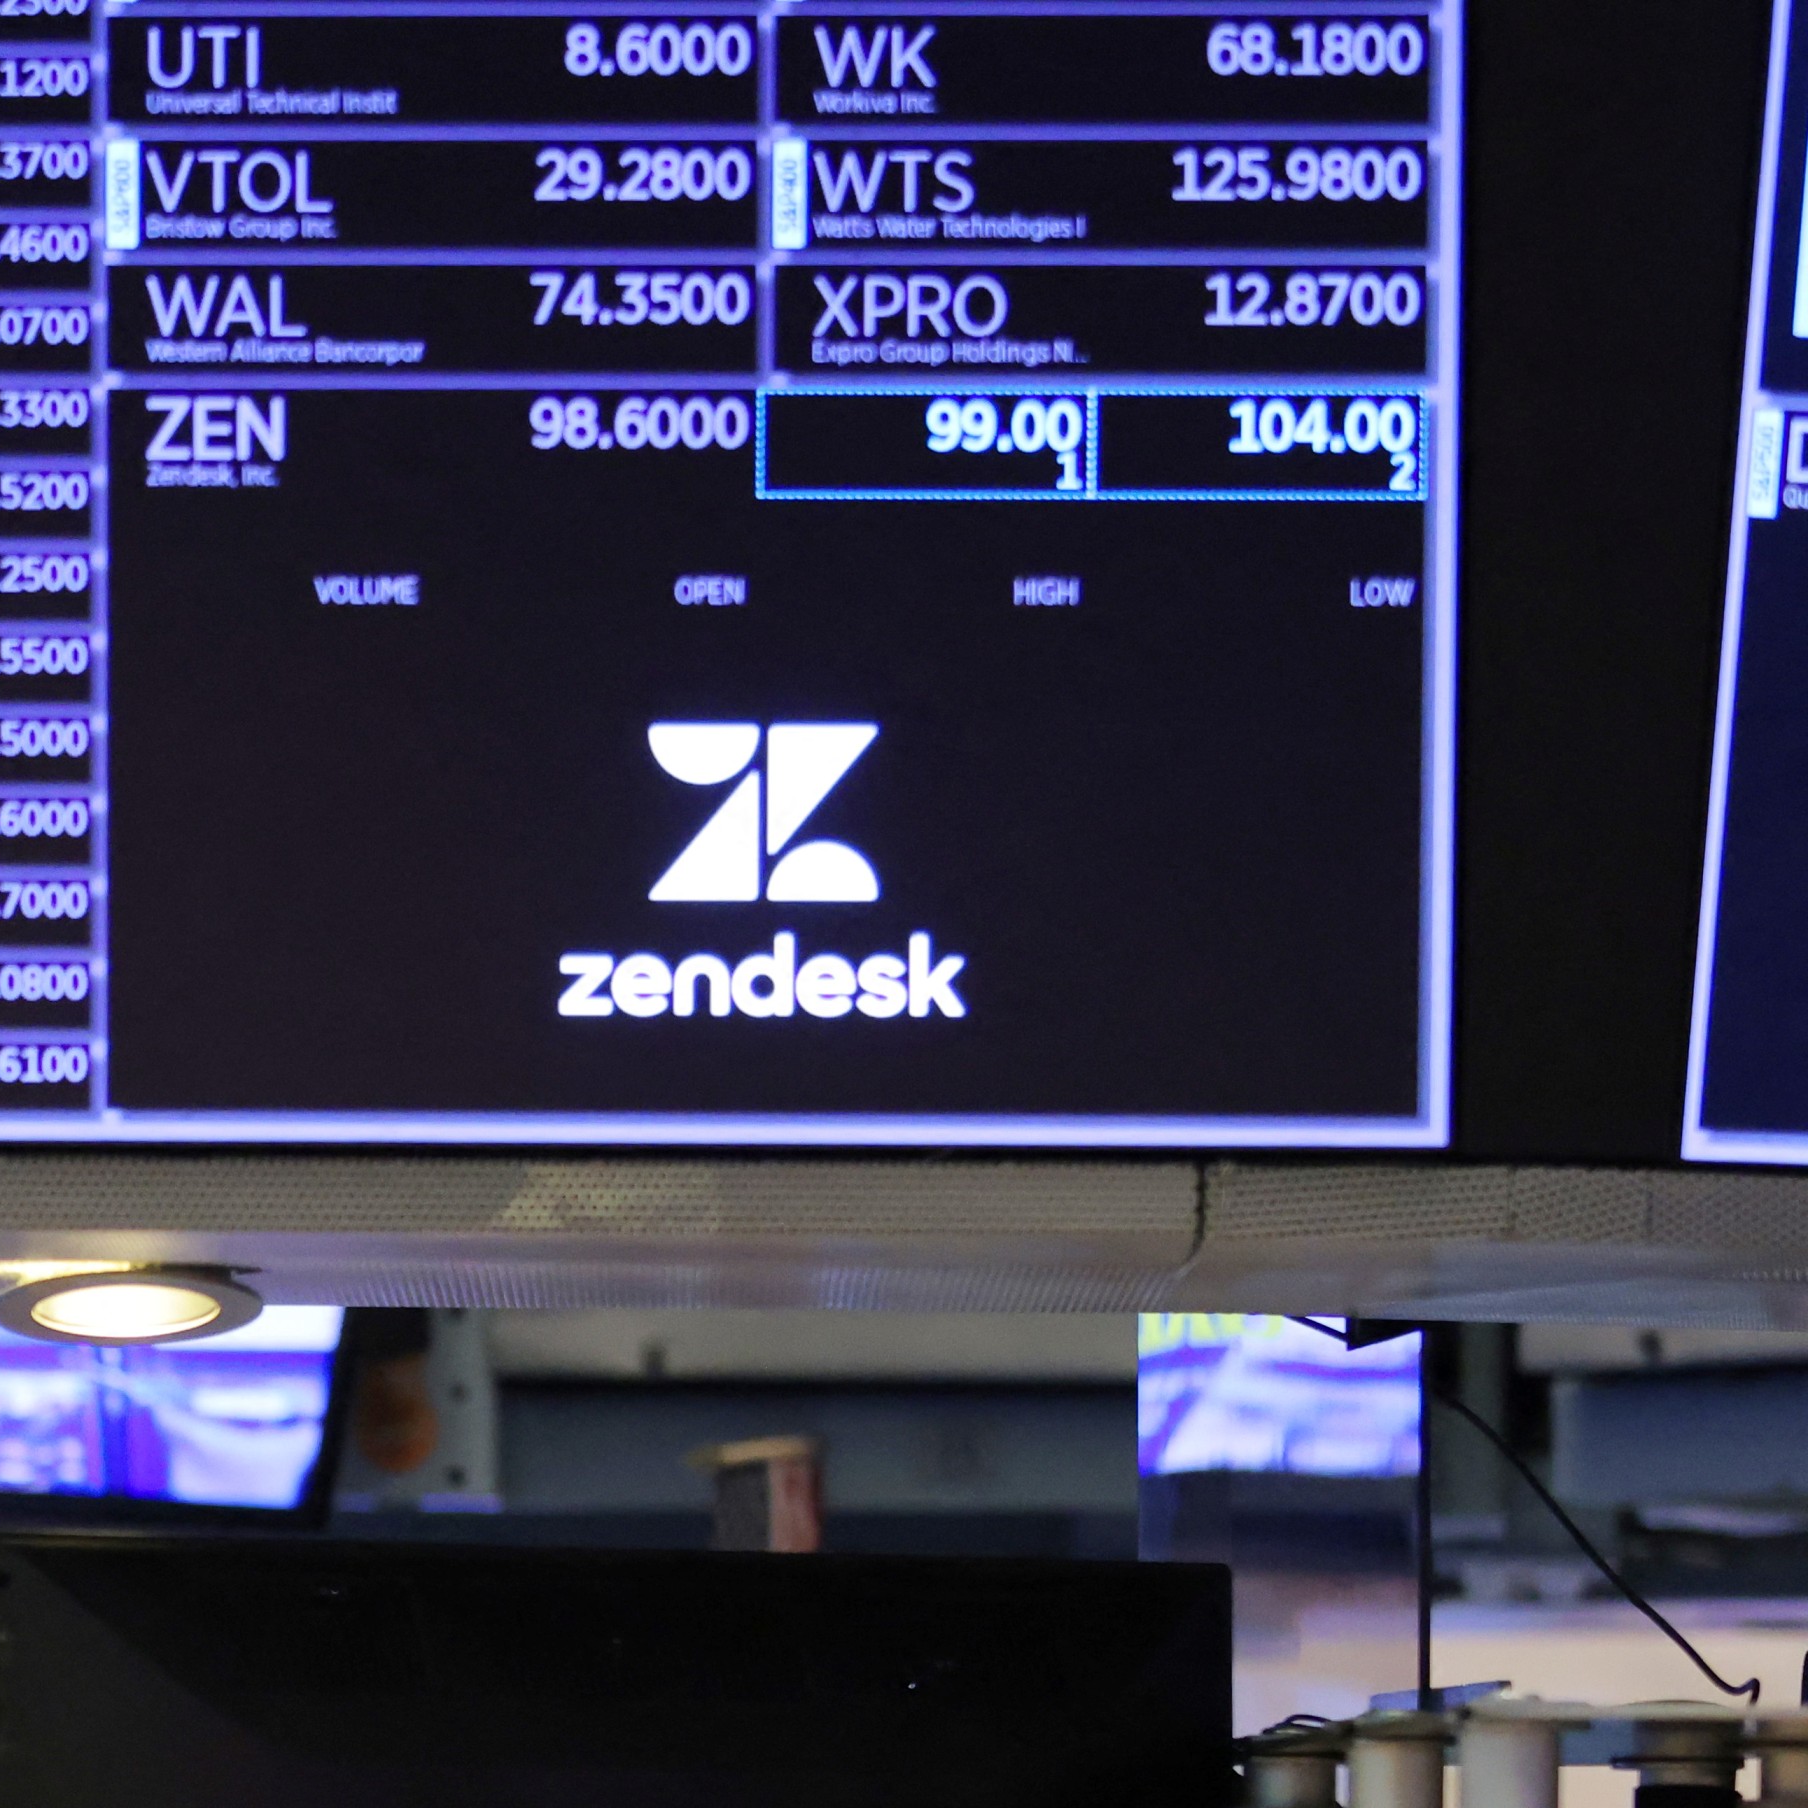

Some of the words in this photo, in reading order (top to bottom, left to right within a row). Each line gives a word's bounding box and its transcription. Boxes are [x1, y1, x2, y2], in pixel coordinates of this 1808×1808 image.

[149, 28, 257, 87] UTI
[564, 24, 751, 77] 8.6000
[815, 29, 933, 87] WK
[1208, 25, 1421, 75] 68.1800
[147, 152, 330, 212] VTOL
[535, 150, 749, 200] 29.2800
[814, 152, 972, 212] WTS
[1173, 150, 1420, 200] 125.9800
[229, 213, 298, 243] Group
[813, 214, 875, 239] Watts
[875, 215, 935, 239] Water
[940, 211, 1076, 243] Technologies
[147, 277, 305, 336] WAL
[531, 274, 749, 324] 74.3500
[814, 277, 1005, 336] XPRO
[1205, 275, 1419, 325] 12.8700
[879, 337, 951, 368] Group
[952, 337, 1052, 368] Holdings
[146, 397, 284, 460] ZEN
[530, 399, 748, 449] 98.6000
[925, 399, 1083, 454] 99.00
[1228, 399, 1416, 454] 104.00
[1055, 453, 1083, 491] 1
[1388, 453, 1416, 491] 2
[315, 577, 414, 604] VOLUME
[675, 578, 744, 605] OPEN
[1014, 580, 1077, 605] HIGH
[1351, 581, 1413, 606] LOW
[557, 931, 967, 1019] zendesk
